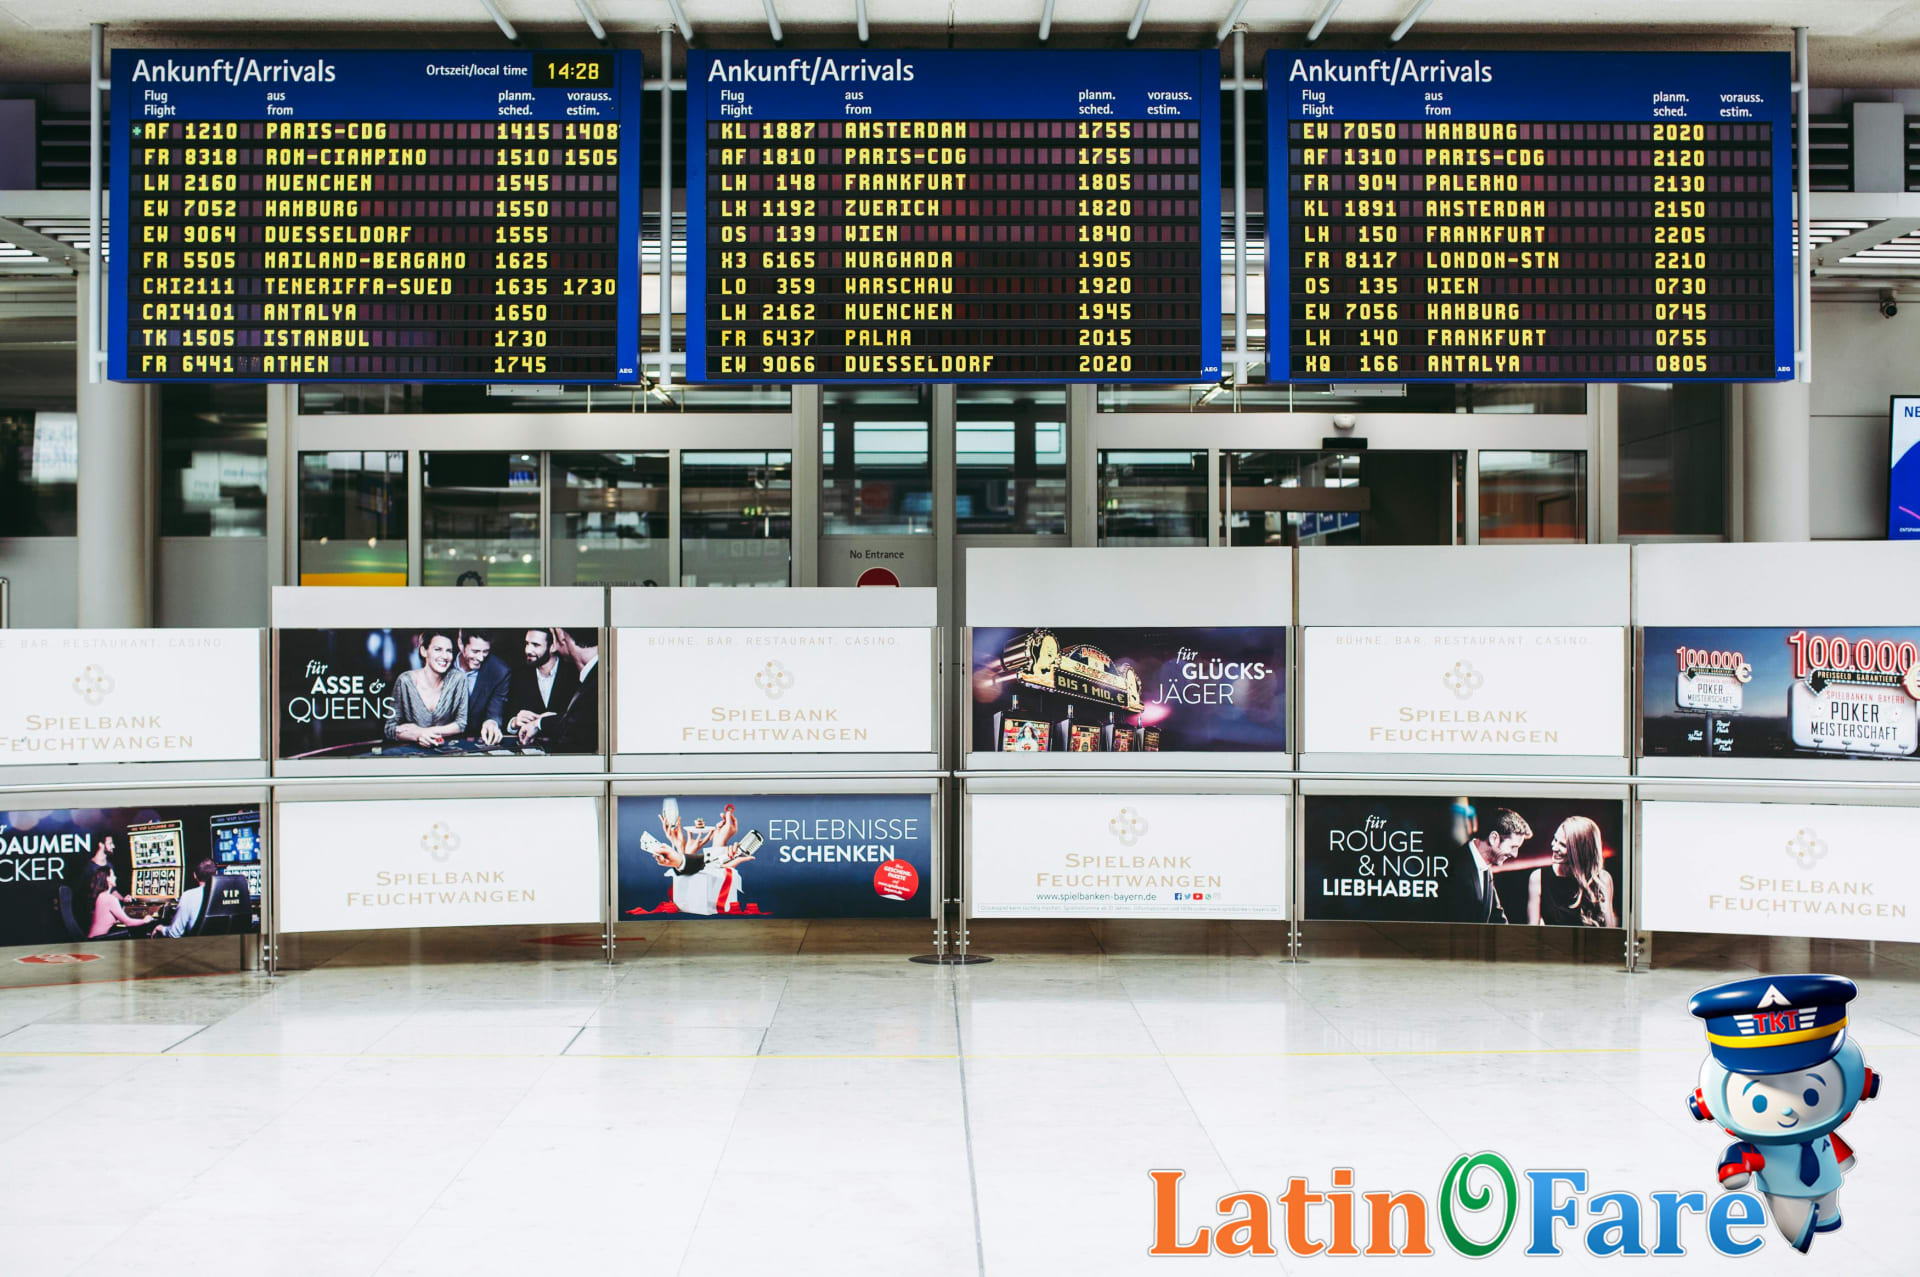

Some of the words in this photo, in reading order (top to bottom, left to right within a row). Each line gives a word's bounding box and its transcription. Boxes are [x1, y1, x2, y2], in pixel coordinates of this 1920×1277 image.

[132, 57, 336, 86] Ankunft/Arrivals
[427, 64, 506, 77] Ortszeit/local
[549, 63, 598, 79] 14:28
[708, 57, 914, 85] Ankunft/Arrivals
[1290, 57, 1492, 85] Ankunft/Arrivals
[145, 90, 167, 103] Flug
[499, 91, 535, 103] planm.
[567, 93, 611, 101] vorauss.
[721, 90, 744, 103] Flug
[845, 92, 863, 100] aus
[1079, 89, 1115, 102] planm.
[1148, 92, 1192, 100] vorauss.
[1303, 90, 1325, 103] Flug
[1654, 91, 1689, 104] planm.
[1720, 93, 1764, 103] vorauss.
[145, 104, 175, 118] Flight
[267, 104, 293, 115] from
[498, 104, 532, 115] sched.
[567, 105, 599, 115] estim.
[721, 104, 752, 118] Flight
[846, 104, 871, 114] from
[1079, 104, 1113, 114] sched.
[1147, 104, 1180, 114] estim.
[1303, 104, 1334, 117] Flight
[1425, 104, 1451, 115] from
[1654, 106, 1687, 116] sched.
[1720, 106, 1752, 117] estim.
[144, 122, 169, 140] AF
[185, 122, 237, 140] 1210
[266, 122, 386, 140] PARIS-CDG
[497, 122, 549, 140] 1415
[565, 123, 618, 140] 1408
[721, 122, 747, 139] KL
[763, 122, 815, 139] 1887
[845, 121, 966, 139] AMSTERDAM
[1079, 121, 1131, 139] 1755
[1303, 122, 1328, 140] EW
[1344, 122, 1396, 140] 7050
[1425, 123, 1517, 140] HAMBURG
[1653, 124, 1704, 141] 2020
[144, 148, 169, 165] FR
[185, 148, 237, 166] 8318
[266, 148, 427, 166] ROM-CIAMPINO
[497, 148, 549, 166] 1510
[565, 148, 617, 166] 1505
[1303, 148, 1329, 165] AF
[1344, 148, 1397, 166] 1310
[1425, 148, 1545, 166] PARIS-CDG
[1653, 149, 1705, 167] 2120
[721, 174, 747, 191] LH
[776, 174, 815, 191] 148
[845, 173, 966, 191] FRANKFURT
[1079, 173, 1131, 191] 1805
[1304, 174, 1329, 191] FR
[1358, 174, 1397, 191] 904
[1426, 174, 1518, 192] PALERMO
[1654, 175, 1705, 192] 2130
[143, 199, 169, 217] EW
[184, 199, 236, 217] 7052
[265, 200, 358, 217] HAMBURG
[496, 200, 548, 217] 1550
[721, 200, 747, 217] LX
[762, 199, 815, 217] 1192
[845, 199, 939, 217] ZUERICH
[1079, 199, 1131, 217] 1820
[721, 251, 747, 269] X3
[762, 251, 815, 269] 6165
[845, 251, 953, 268] HURGHADA
[1079, 251, 1131, 268] 1905
[1304, 251, 1330, 269] FR
[1345, 251, 1397, 269] 8117
[1426, 251, 1559, 269] LONDON-STN
[1655, 252, 1706, 269] 2210
[265, 277, 452, 295] TENERIFFA-SUED
[495, 278, 547, 295] 1635
[563, 278, 616, 296] 1730
[721, 278, 746, 295] LO
[777, 277, 815, 295] 359
[845, 277, 953, 295] WARSCHAU
[1079, 277, 1131, 294] 1920
[264, 303, 356, 321] ANTALYA
[495, 304, 547, 321] 1650
[142, 355, 167, 373] FR
[182, 355, 233, 373] 6441
[263, 355, 329, 373] ATHEN
[494, 356, 546, 373] 1745
[1305, 355, 1331, 372] XQ
[1360, 355, 1398, 372] 166
[1428, 355, 1520, 372] ANTALYA
[1656, 355, 1707, 372] 0805
[850, 550, 862, 558] No
[865, 550, 904, 558] Entrance
[1176, 647, 1199, 665] für
[1676, 645, 1744, 672] 100.000
[1788, 630, 1917, 678] 100.000
[306, 659, 328, 681] für
[1182, 657, 1273, 681] GLÜCKS-
[1735, 662, 1752, 683] €
[1817, 671, 1852, 680] PREISGELD
[1856, 673, 1898, 683] GARANTIERT
[311, 676, 363, 694] ASSE
[369, 679, 385, 694] &
[1058, 676, 1079, 691] BIS
[1082, 684, 1088, 694] 1
[1092, 686, 1115, 702] MIO.
[1116, 693, 1125, 704] €
[1152, 677, 1235, 705] JÄGER
[1697, 684, 1724, 696] POKER
[289, 696, 397, 724] QUEENS
[711, 706, 838, 722] SPIELBANK
[1399, 706, 1528, 723] SPIELBANK
[1831, 702, 1879, 723] POKER
[26, 714, 162, 731] SPIELBANK
[1811, 721, 1898, 741] MEISTERSCHAFT
[682, 727, 867, 742] FEUCHTWANGEN
[1369, 727, 1558, 743] FEUCHTWANGEN
[768, 818, 918, 840] ERLEBNISSE
[1365, 814, 1387, 832] für
[1329, 829, 1424, 853] ROUGE
[779, 845, 895, 863] SCHENKEN
[1065, 853, 1191, 869] SPIELBANK
[1358, 855, 1376, 877] &
[1383, 855, 1449, 878] NOIR
[376, 870, 505, 886] SPIELBANK
[1036, 872, 1222, 888] FEUCHTWANGEN
[1739, 875, 1874, 896] SPIELBANK
[223, 889, 240, 898] VIP
[1036, 892, 1157, 902] www.spielbanken-bayern.de
[1322, 878, 1439, 898] LIEBHABER
[346, 889, 536, 907] FEUCHTWANGEN
[1708, 894, 1907, 918] FEUCHTWANGEN
